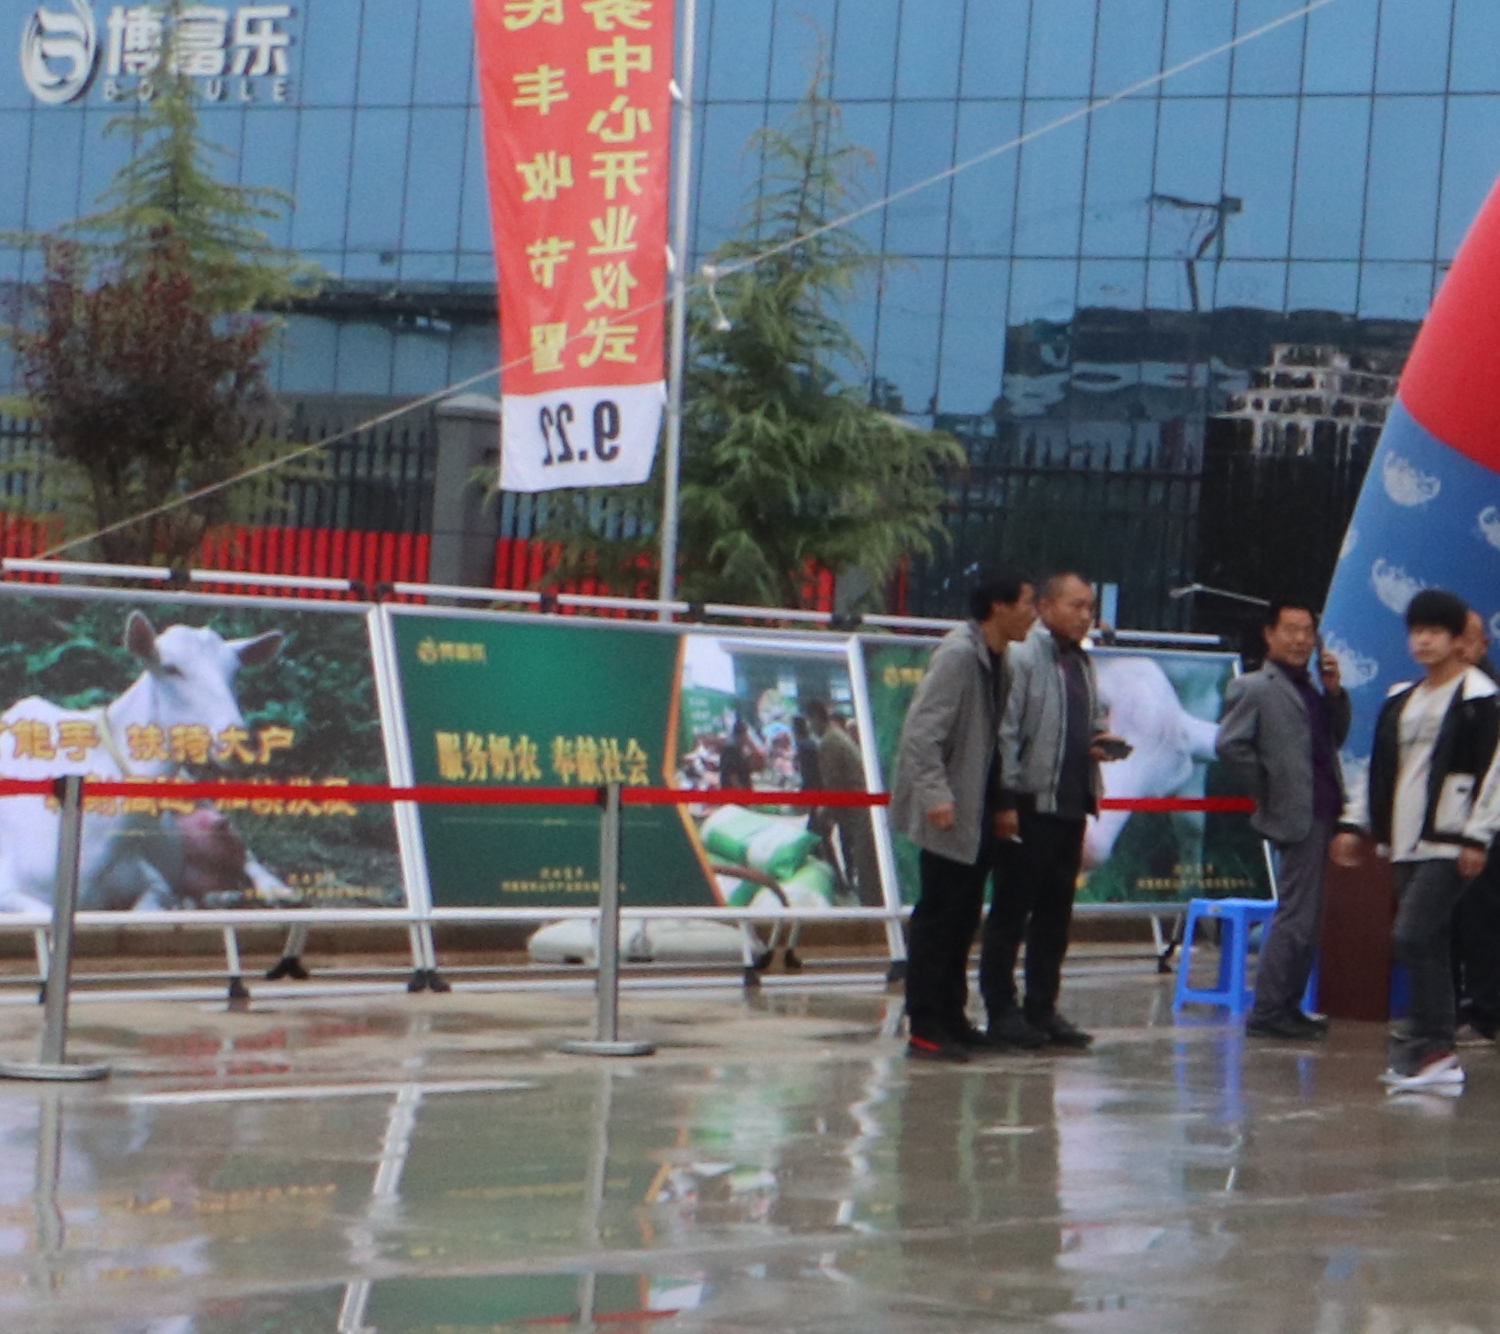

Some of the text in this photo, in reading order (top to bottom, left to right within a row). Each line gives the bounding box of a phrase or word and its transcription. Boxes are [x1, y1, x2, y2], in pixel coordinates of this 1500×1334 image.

[105, 4, 292, 77] 博富乐
[102, 81, 288, 103] BOULE
